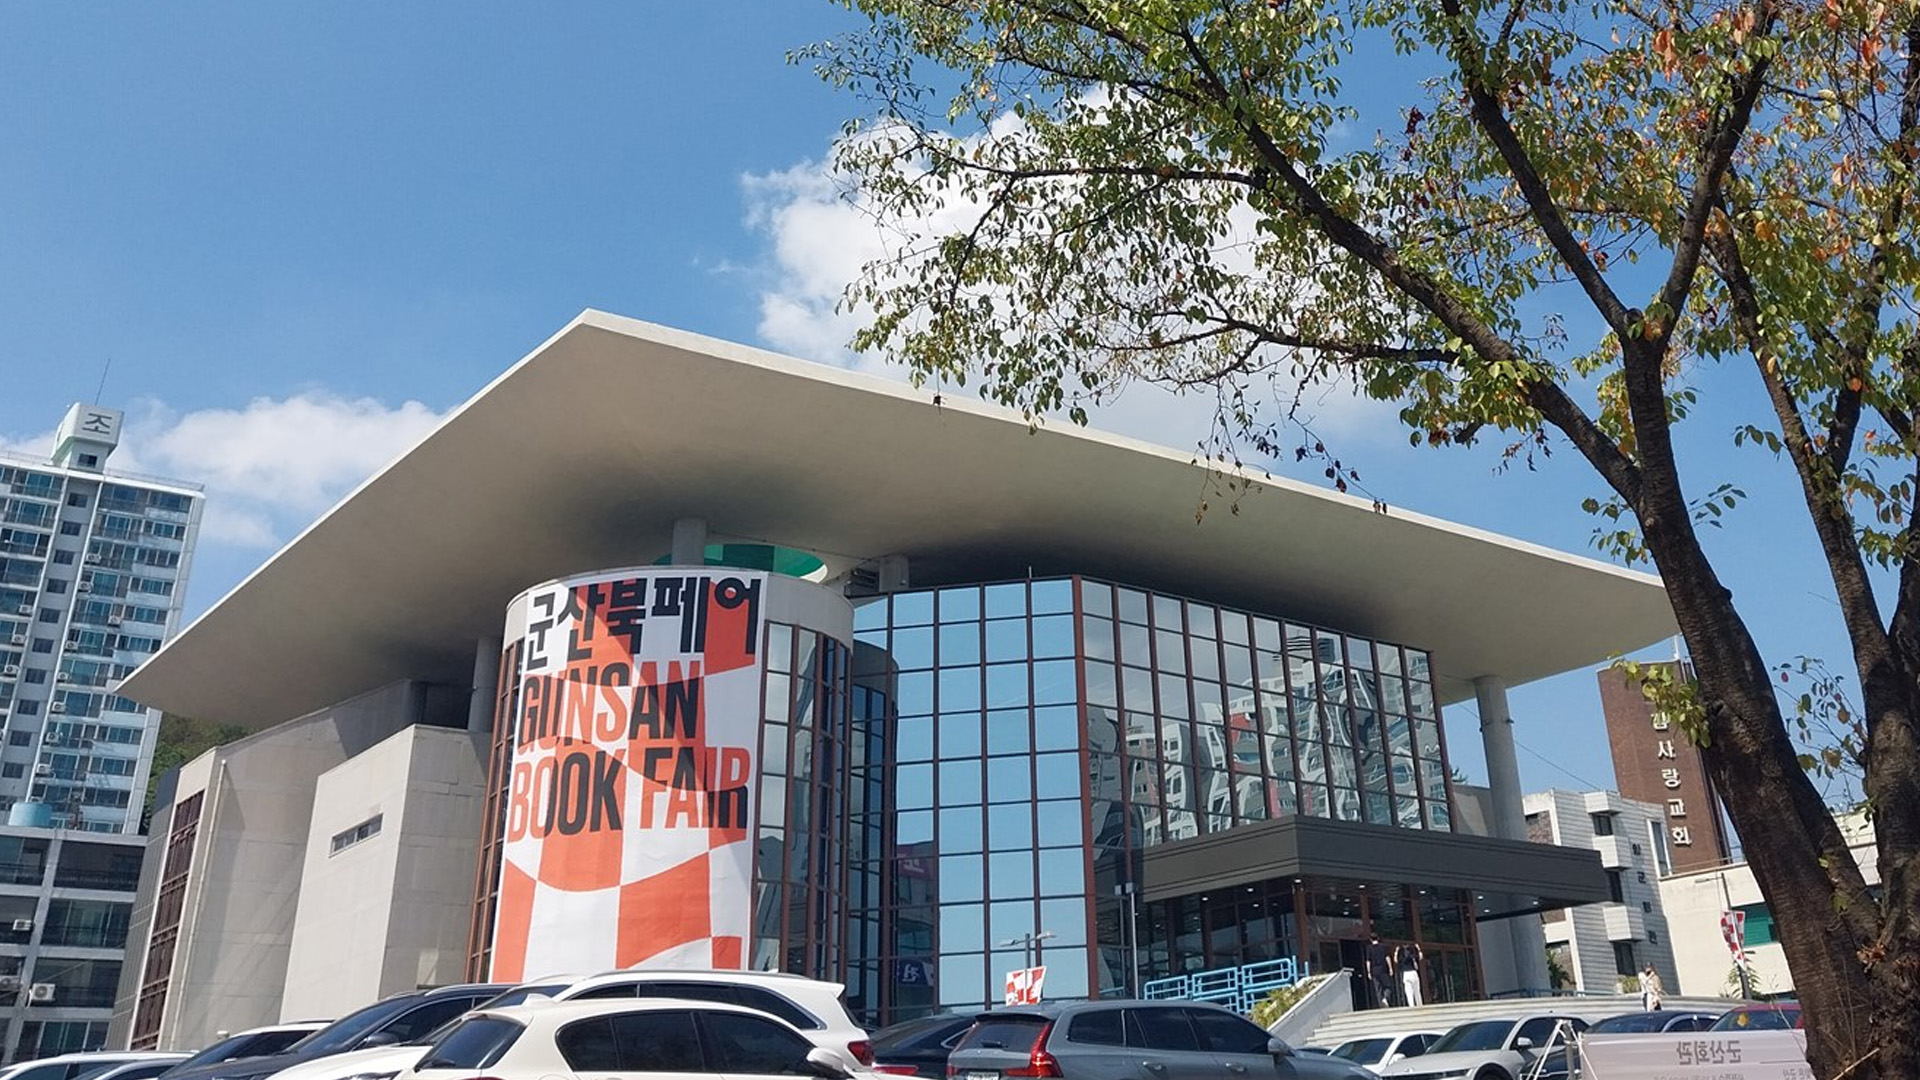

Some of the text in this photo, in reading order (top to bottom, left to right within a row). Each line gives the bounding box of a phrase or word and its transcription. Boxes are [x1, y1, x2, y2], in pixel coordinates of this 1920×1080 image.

[82, 412, 112, 435] 조
[526, 576, 762, 672] 군산북페어
[517, 660, 706, 756] GUNSAN
[506, 746, 751, 843] BOOK FAIR
